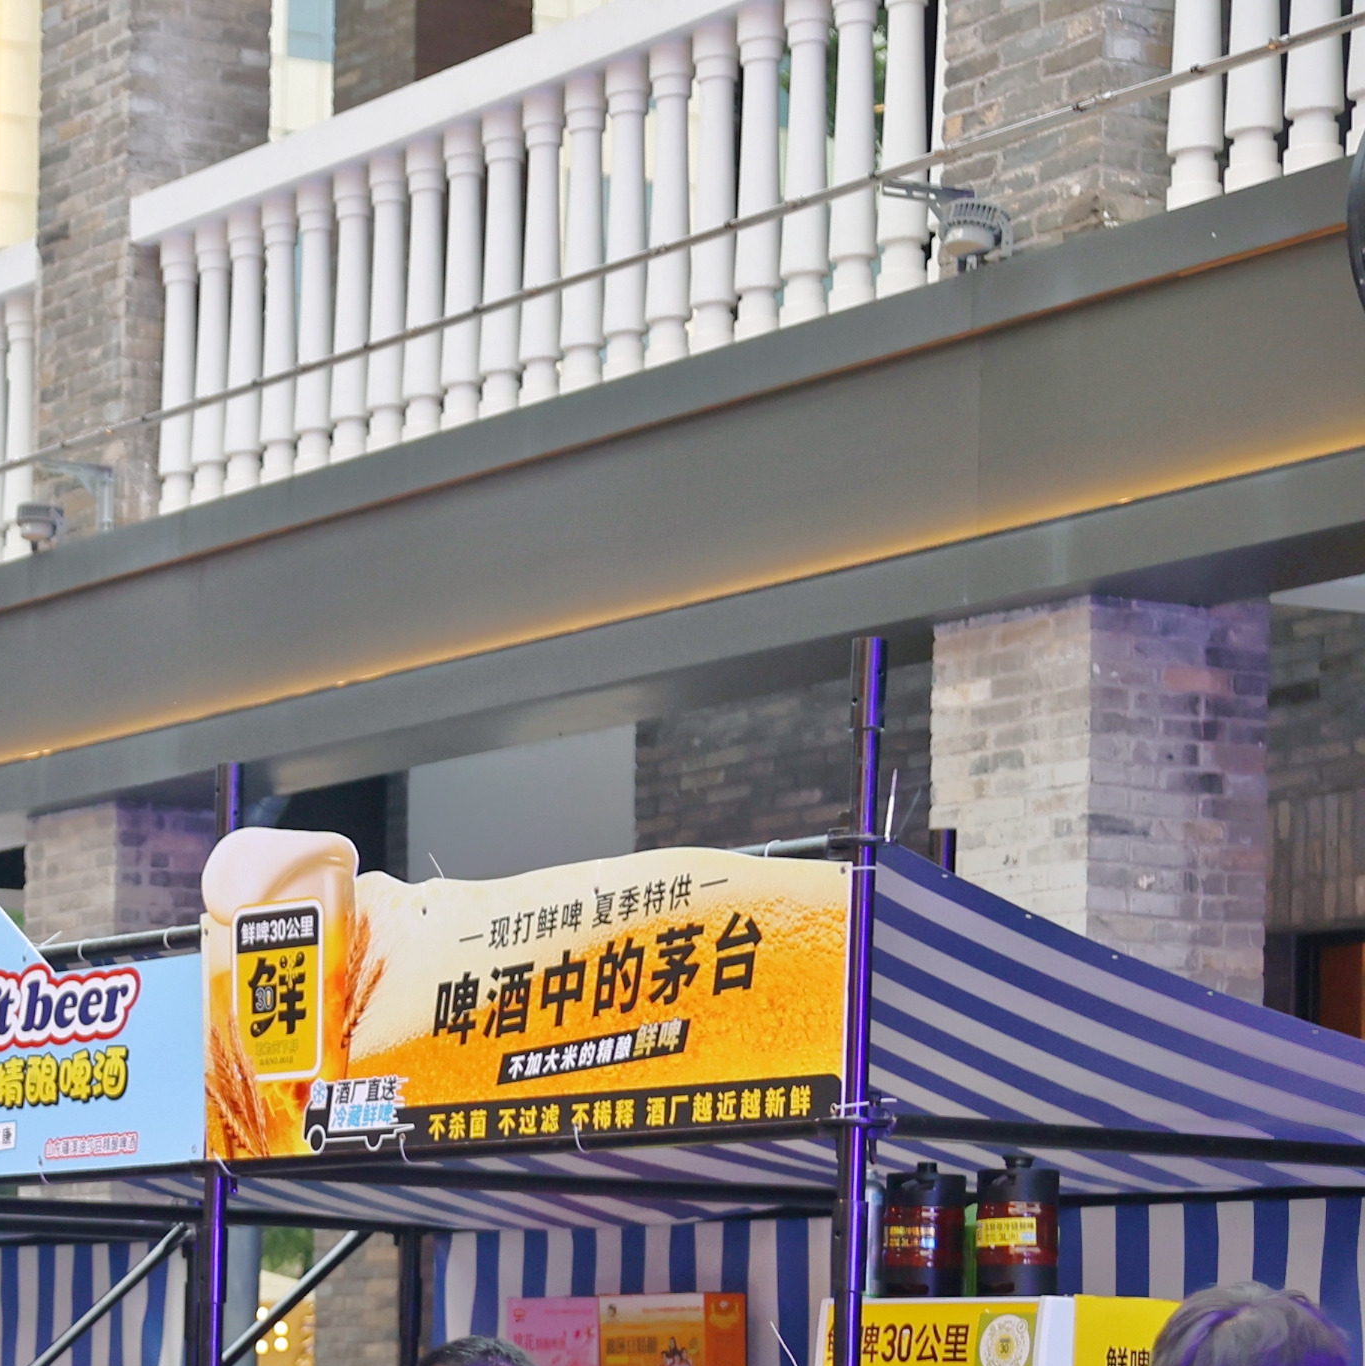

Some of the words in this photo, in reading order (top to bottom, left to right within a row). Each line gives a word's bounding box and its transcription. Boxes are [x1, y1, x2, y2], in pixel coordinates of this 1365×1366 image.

[241, 914, 315, 946] 鲜啤30公里
[488, 898, 583, 951] 现打鲜啤
[592, 873, 693, 930] 夏季特供
[21, 978, 128, 1032] beer
[433, 911, 762, 1045] 啤酒中的茅台
[508, 1016, 682, 1080] 不加大米的精酿鲜啤
[332, 1103, 395, 1128] 冷藏鲜啤
[336, 1076, 399, 1104] 酒厂直送
[428, 1110, 487, 1140] 不杀菌
[498, 1104, 560, 1136] 不过滤
[571, 1099, 635, 1132] 不稀释
[646, 1085, 811, 1127] 酒厂越近越新鲜
[827, 1323, 971, 1364] 啤30公里
